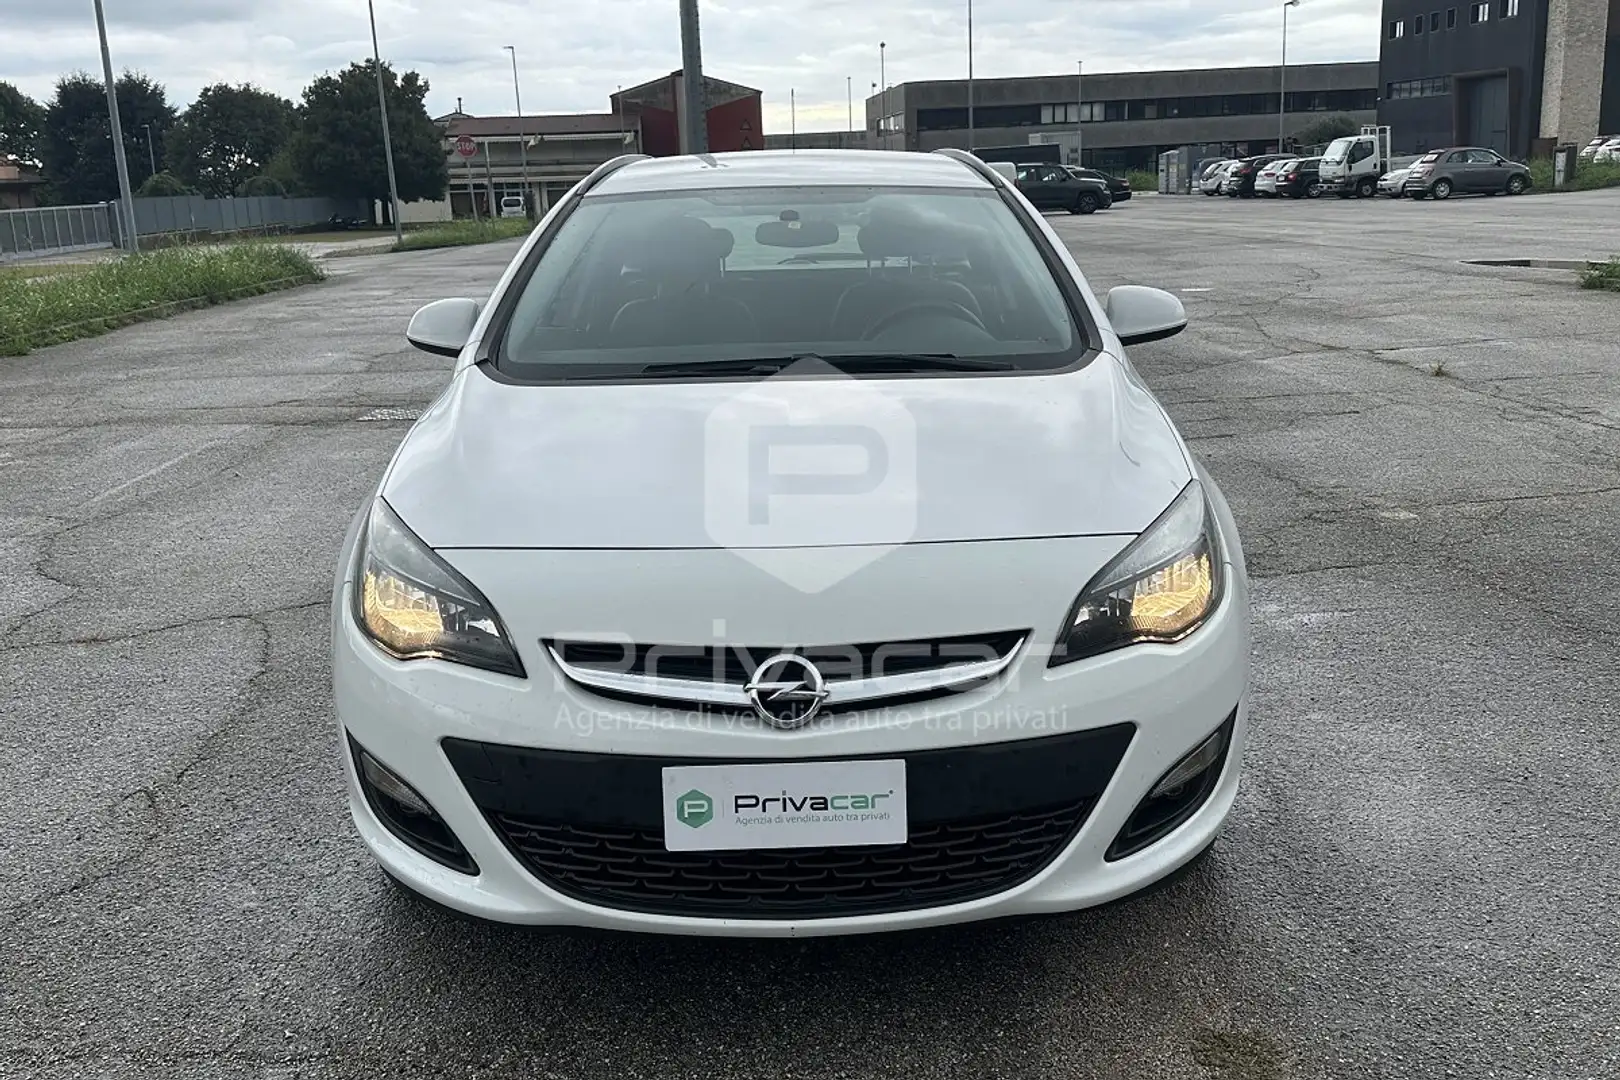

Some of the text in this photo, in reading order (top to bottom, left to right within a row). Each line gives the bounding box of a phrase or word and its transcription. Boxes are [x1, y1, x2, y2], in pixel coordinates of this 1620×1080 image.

[457, 141, 475, 151] STOP
[684, 800, 708, 818] P
[734, 790, 890, 813] Privacar
[735, 810, 890, 826] Agenzia di vendita auto tra privati
